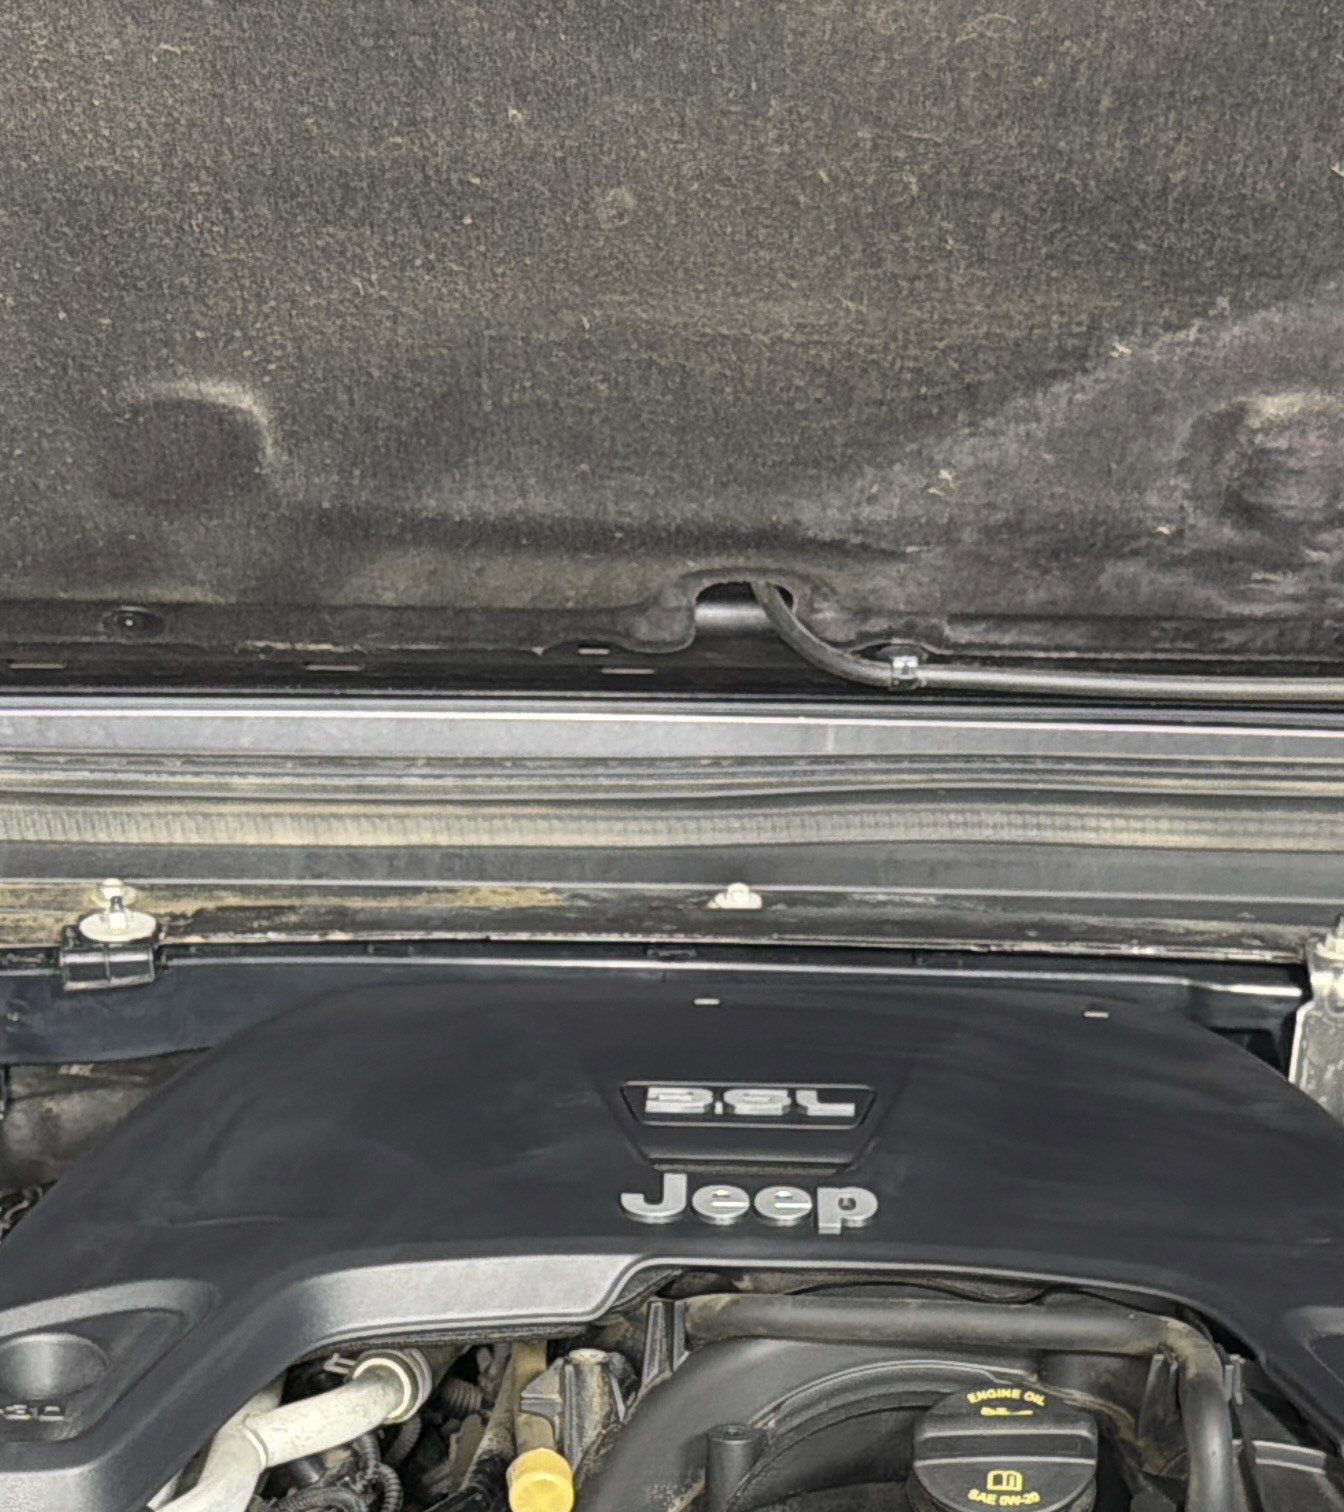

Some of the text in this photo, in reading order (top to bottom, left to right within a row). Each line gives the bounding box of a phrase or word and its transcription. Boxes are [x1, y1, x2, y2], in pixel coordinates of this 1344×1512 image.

[620, 1172, 879, 1235] Jeep
[967, 1388, 1045, 1407] ENGINE OIL
[967, 1487, 1041, 1507] SAE 0W-20
